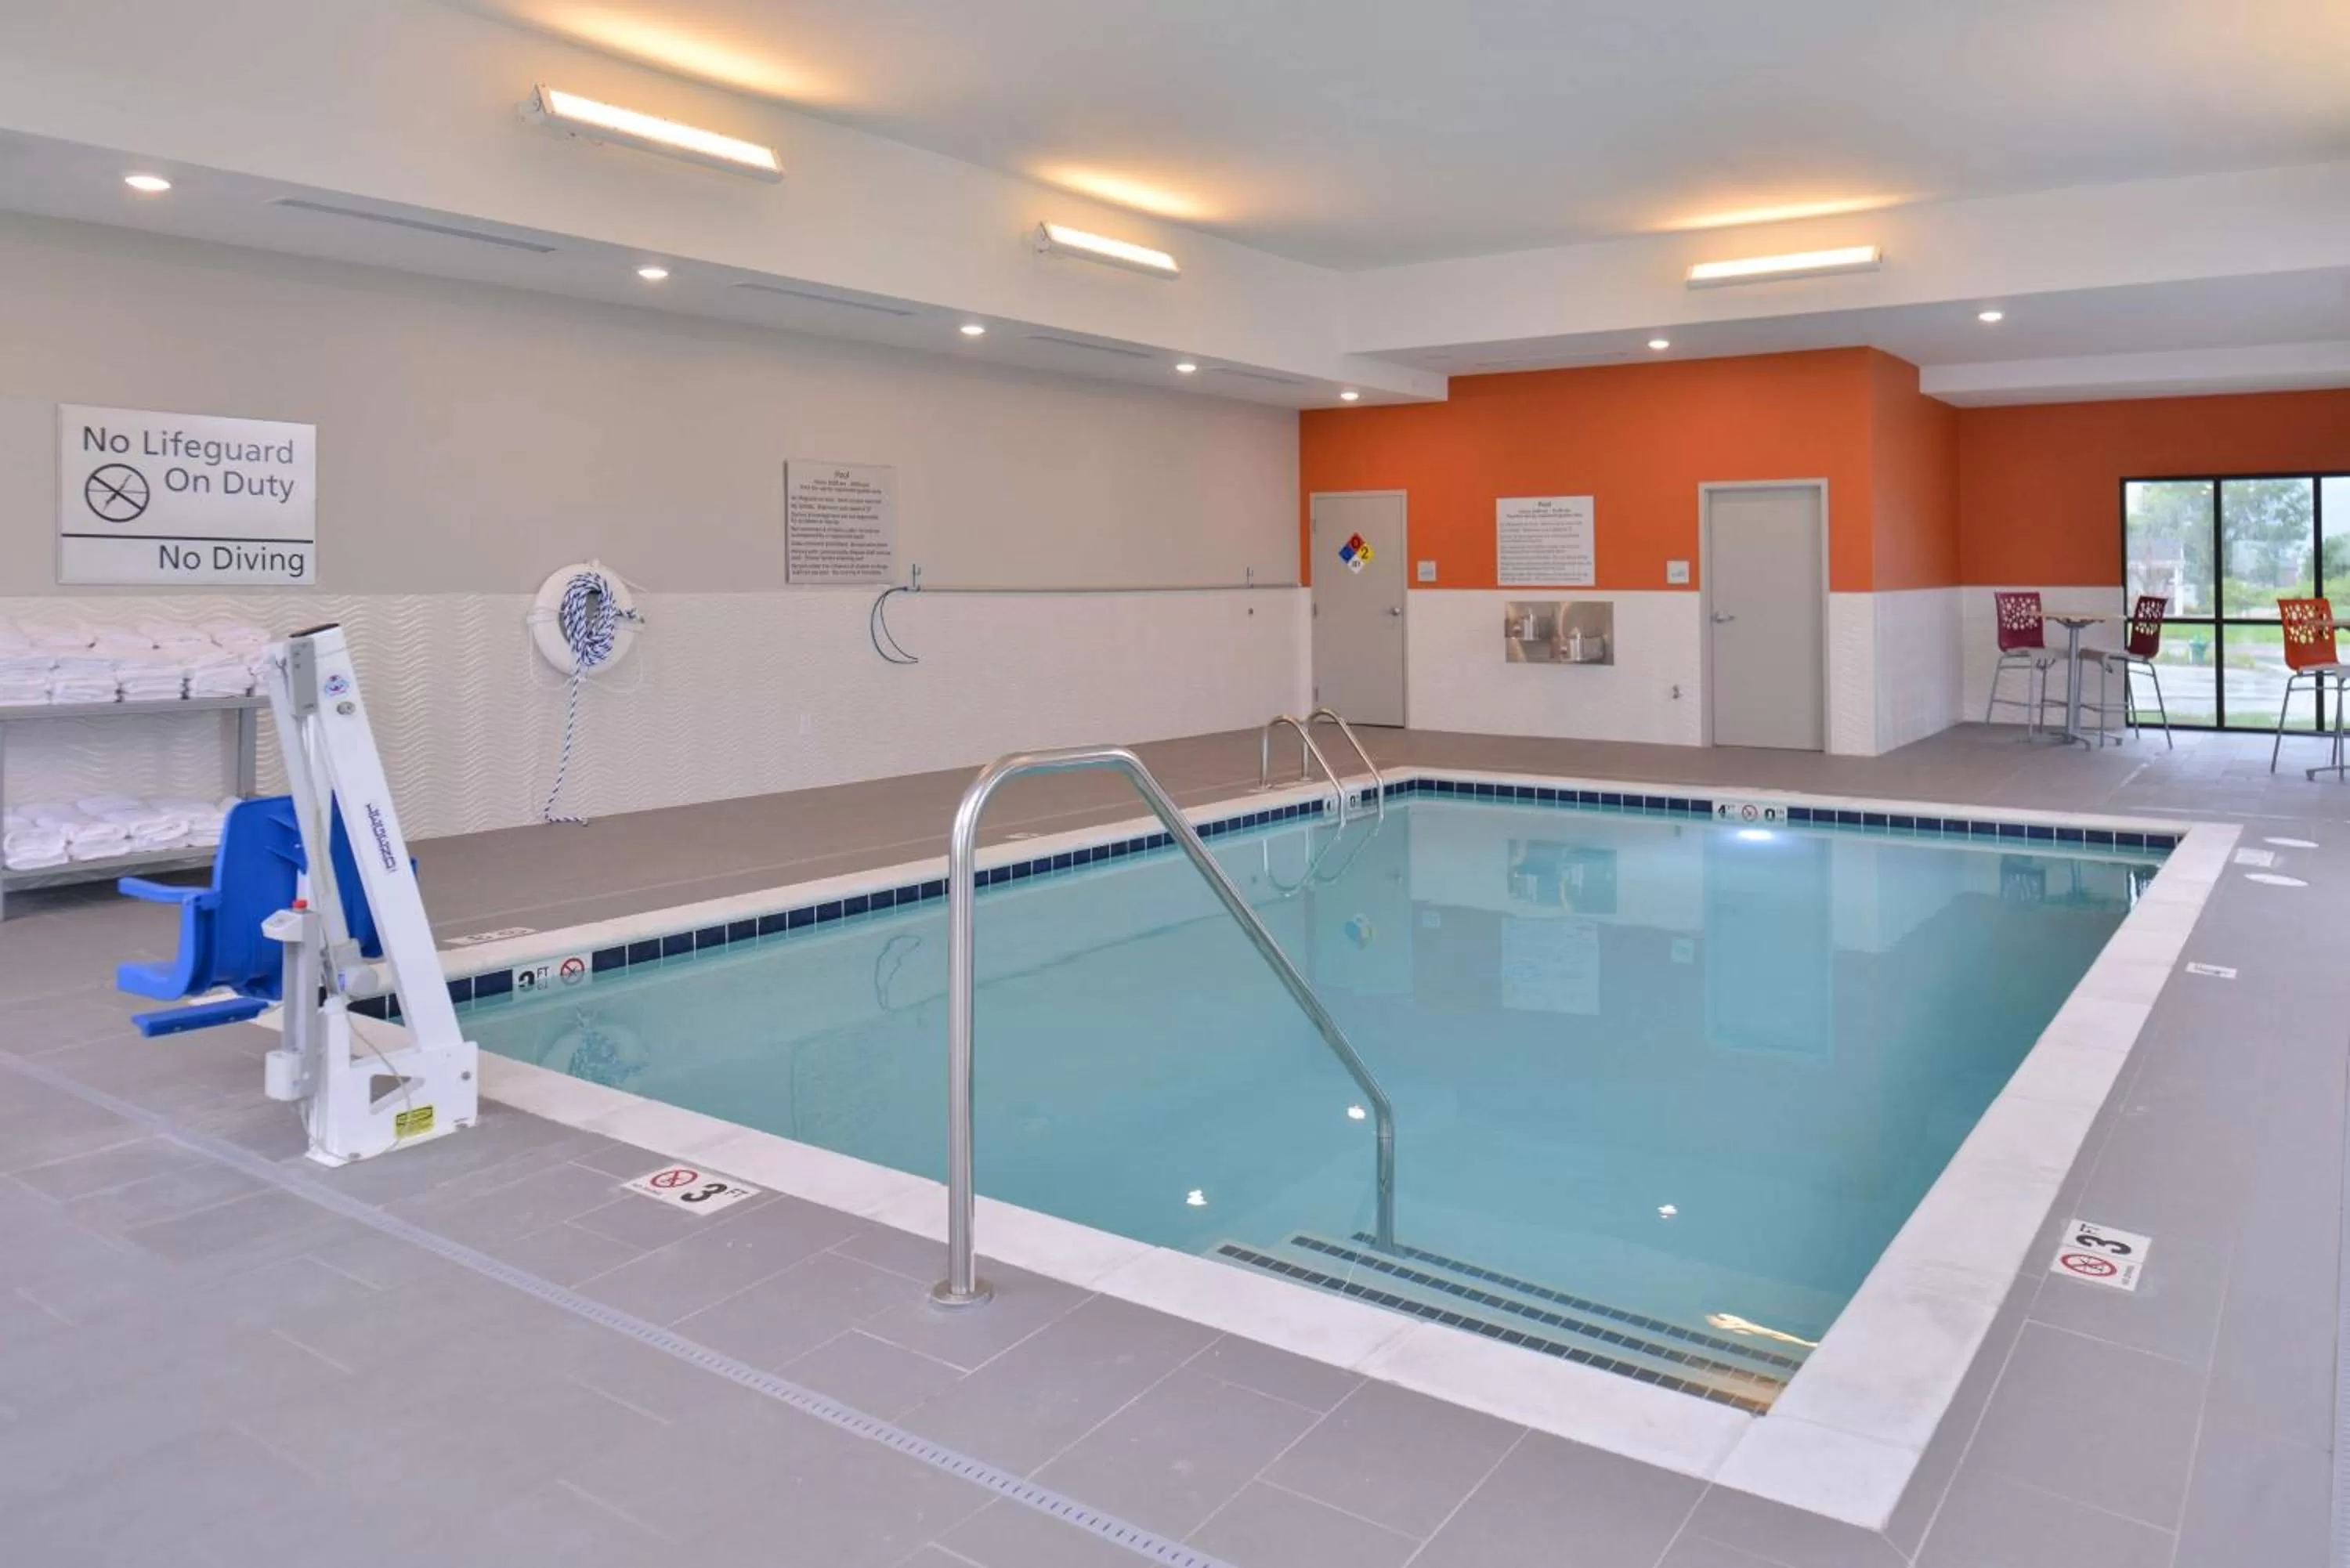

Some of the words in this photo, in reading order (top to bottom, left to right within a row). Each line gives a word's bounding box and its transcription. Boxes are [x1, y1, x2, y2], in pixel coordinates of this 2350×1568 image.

[82, 425, 130, 453] No
[143, 430, 294, 466] Lifeguard
[164, 467, 211, 493] On
[224, 470, 295, 504] Duty
[159, 544, 201, 571] No
[212, 545, 305, 578] Diving
[1361, 546, 1369, 560] 2
[537, 966, 550, 978] FT
[680, 1183, 728, 1203] 3
[725, 1188, 750, 1198] FT
[2075, 1234, 2132, 1255] 3
